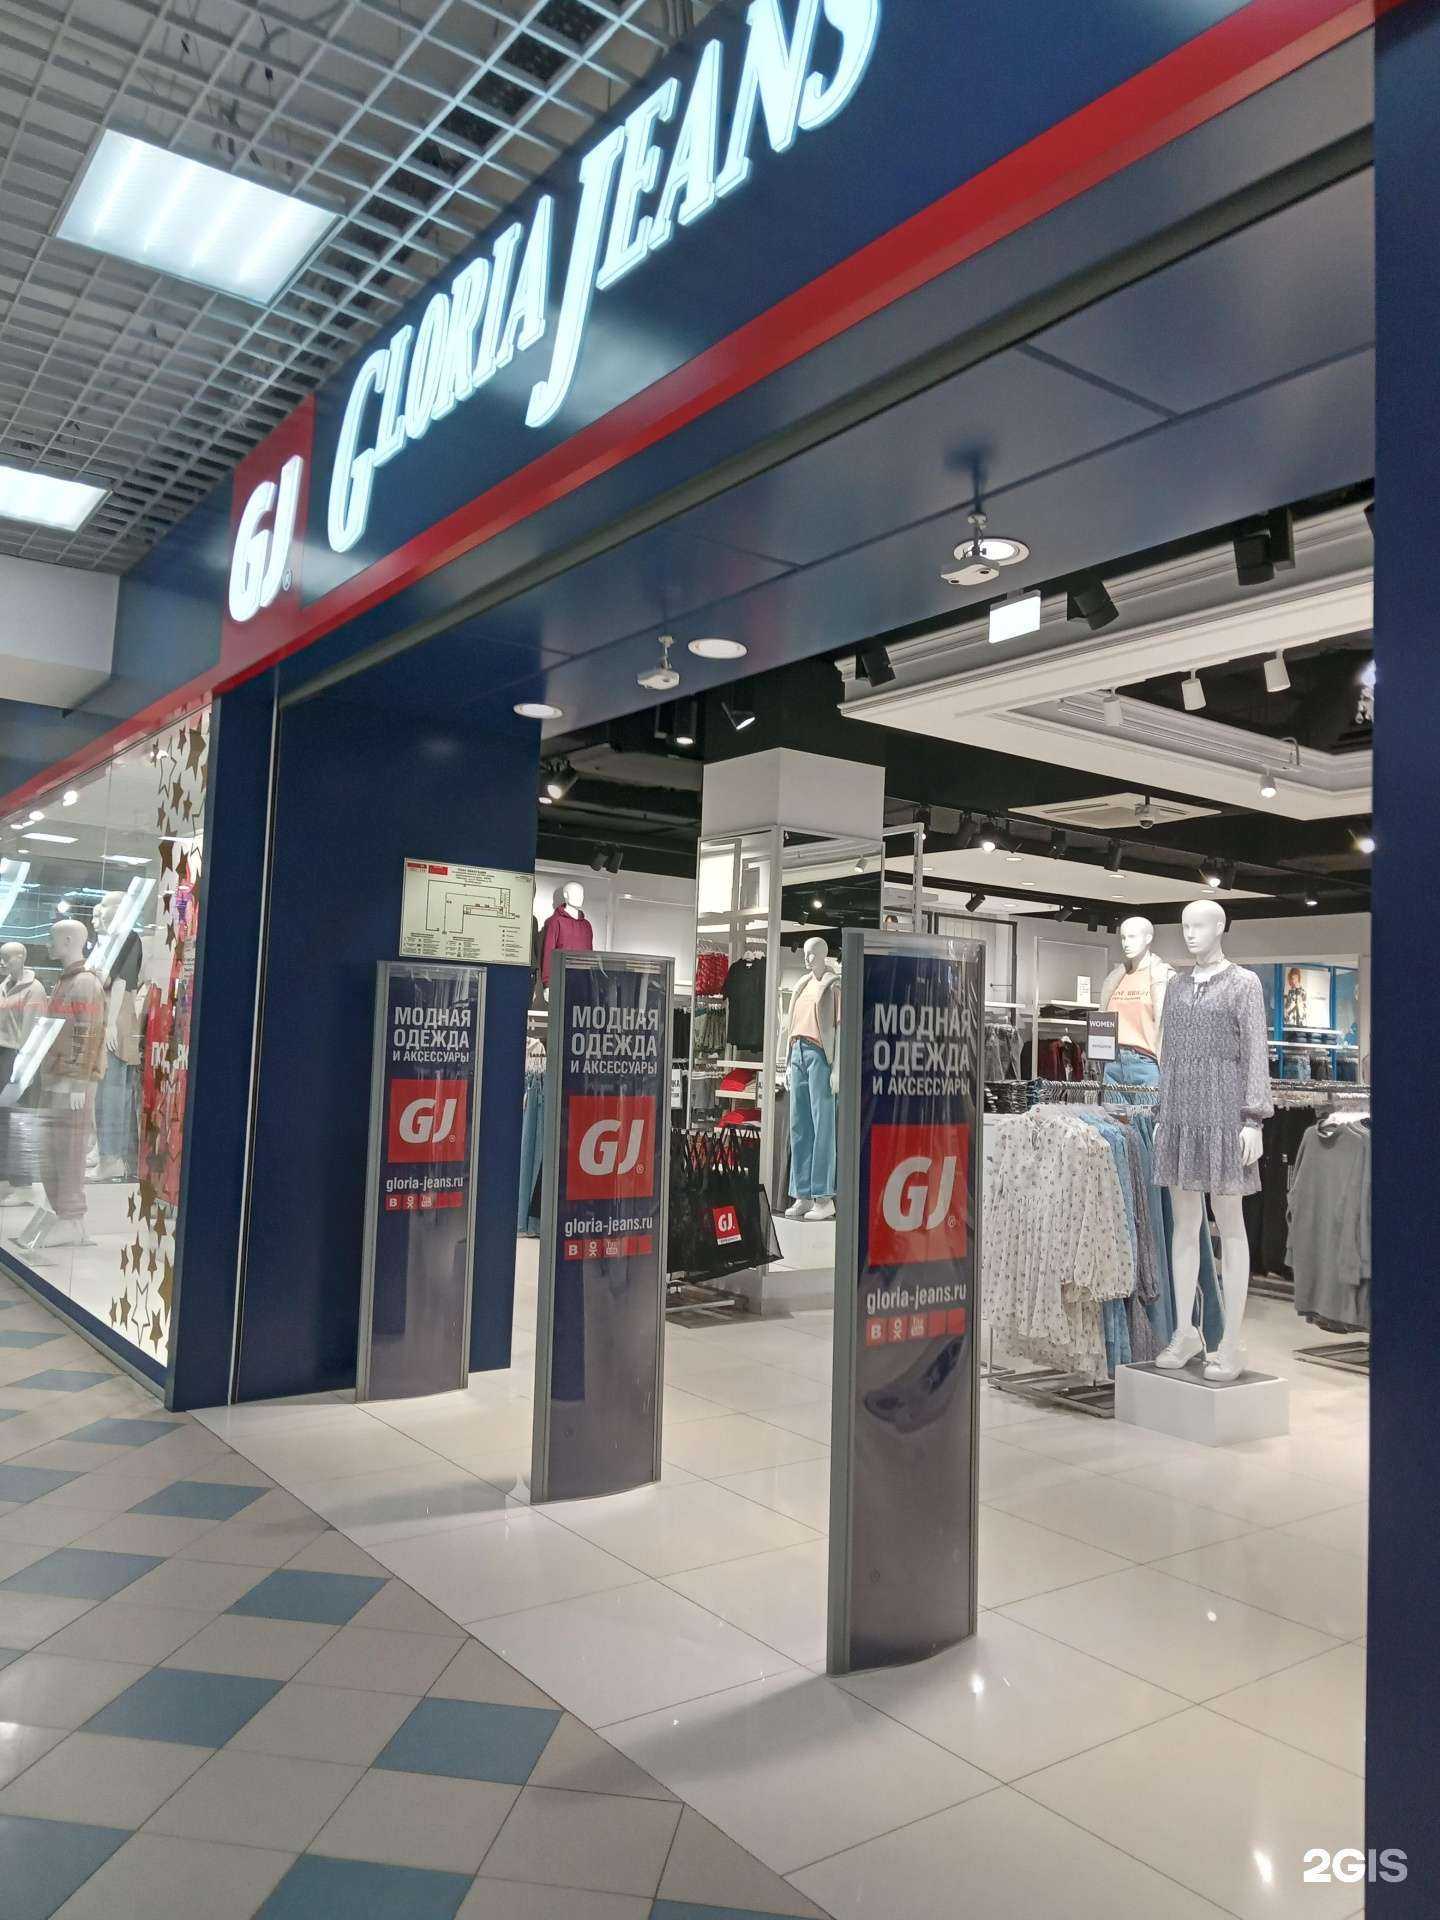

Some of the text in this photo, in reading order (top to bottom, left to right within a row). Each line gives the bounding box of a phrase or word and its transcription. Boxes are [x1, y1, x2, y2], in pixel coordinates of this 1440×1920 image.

[328, 194, 555, 553] GLORIA
[394, 1006, 471, 1029] МОДНАЯ
[572, 1005, 659, 1034] МОДНАЯ
[873, 1003, 971, 1042] МОДНАЯ
[1089, 1019, 1115, 1028] WOMEN
[393, 1029, 470, 1050] ОДЕЖДА
[571, 1033, 657, 1060] ОДЕЖДА
[392, 1050, 470, 1063] И АКСЕССУАРЫ
[570, 1060, 658, 1075] И АКСЕССУАРЫ
[873, 1040, 970, 1076] ОДЕЖДА
[872, 1076, 971, 1096] И АКСЕССУАРЫ
[386, 1176, 464, 1193] gloria-jeans.ru
[564, 1216, 653, 1237] gloria-jeans.ru
[866, 1283, 967, 1315] gloria-jeans.ru
